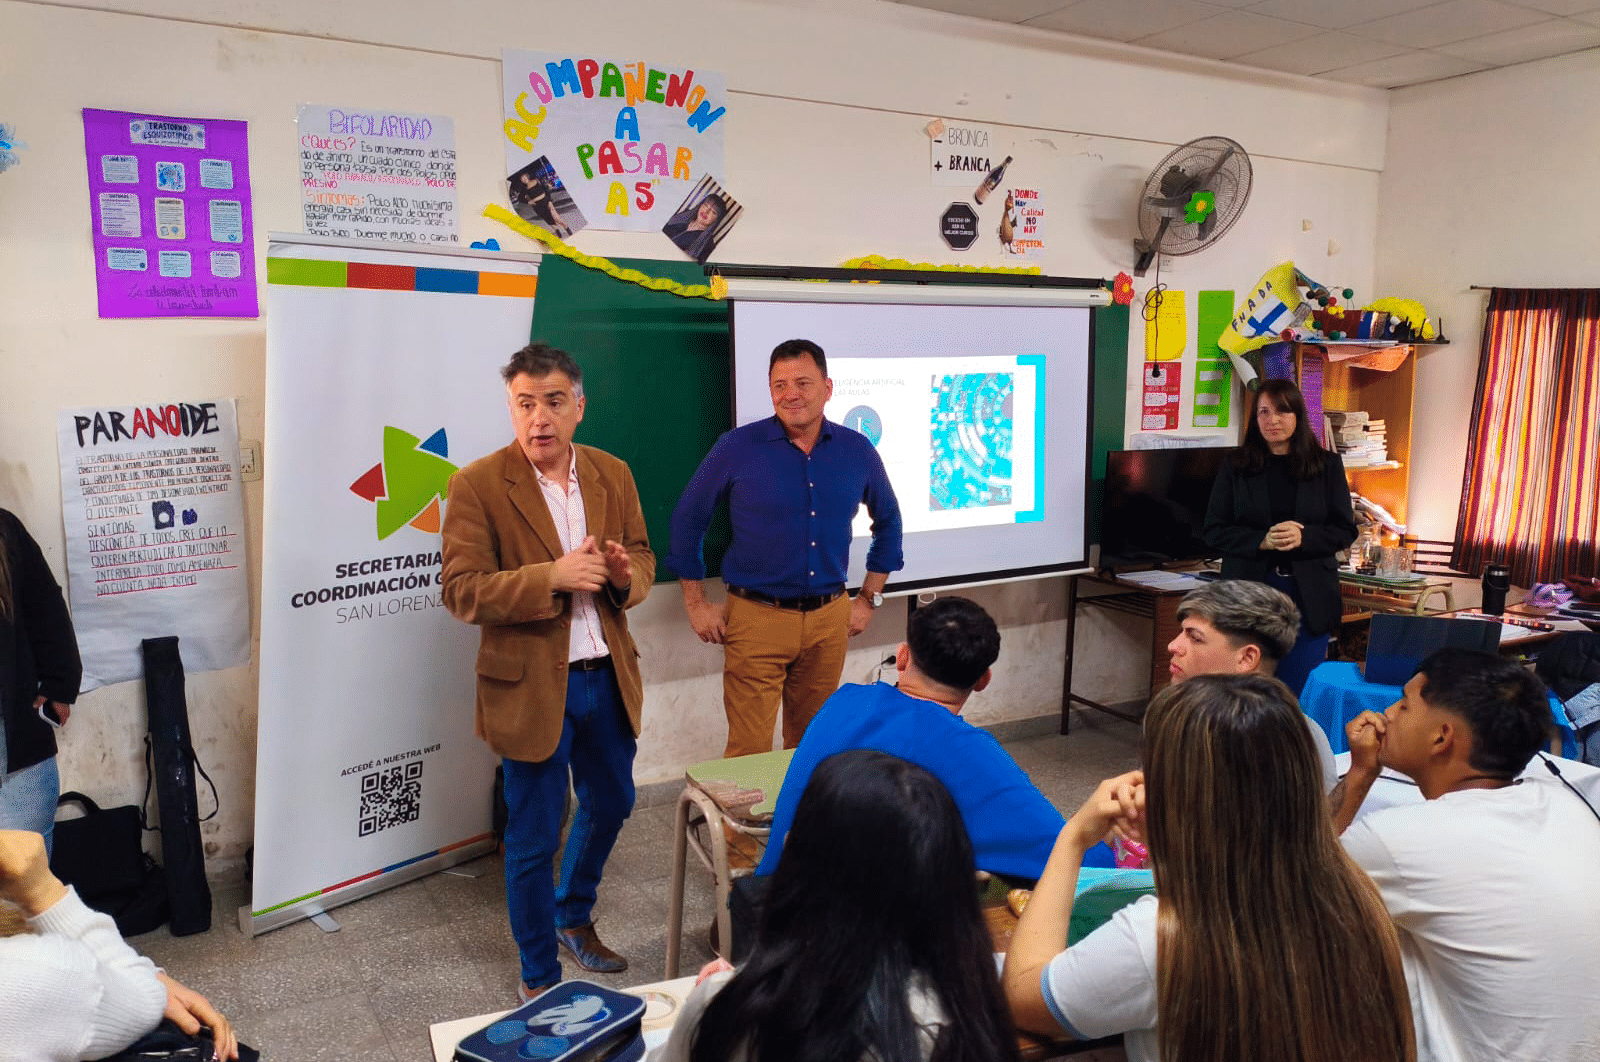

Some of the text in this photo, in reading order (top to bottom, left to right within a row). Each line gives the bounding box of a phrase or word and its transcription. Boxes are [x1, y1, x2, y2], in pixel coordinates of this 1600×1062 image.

[615, 106, 641, 141] A
[948, 127, 990, 147] BRONCA
[577, 140, 693, 180] PASAR
[949, 154, 991, 172] BRANCA
[606, 181, 629, 216] A
[1015, 188, 1038, 200] DONDE
[1023, 226, 1037, 234] HAY
[1025, 216, 1037, 225] NO
[74, 402, 220, 448] PARANOIDE
[98, 503, 140, 519] DISTANTE
[87, 520, 135, 538] SINTOMAS
[167, 561, 187, 574] COMO
[335, 551, 443, 579] SECRETARIA
[290, 571, 431, 608] COORDINACIÓN
[336, 592, 445, 624] SAN LORENZ
[340, 743, 441, 777] ACCEDÉ A NUESTRA WEB
